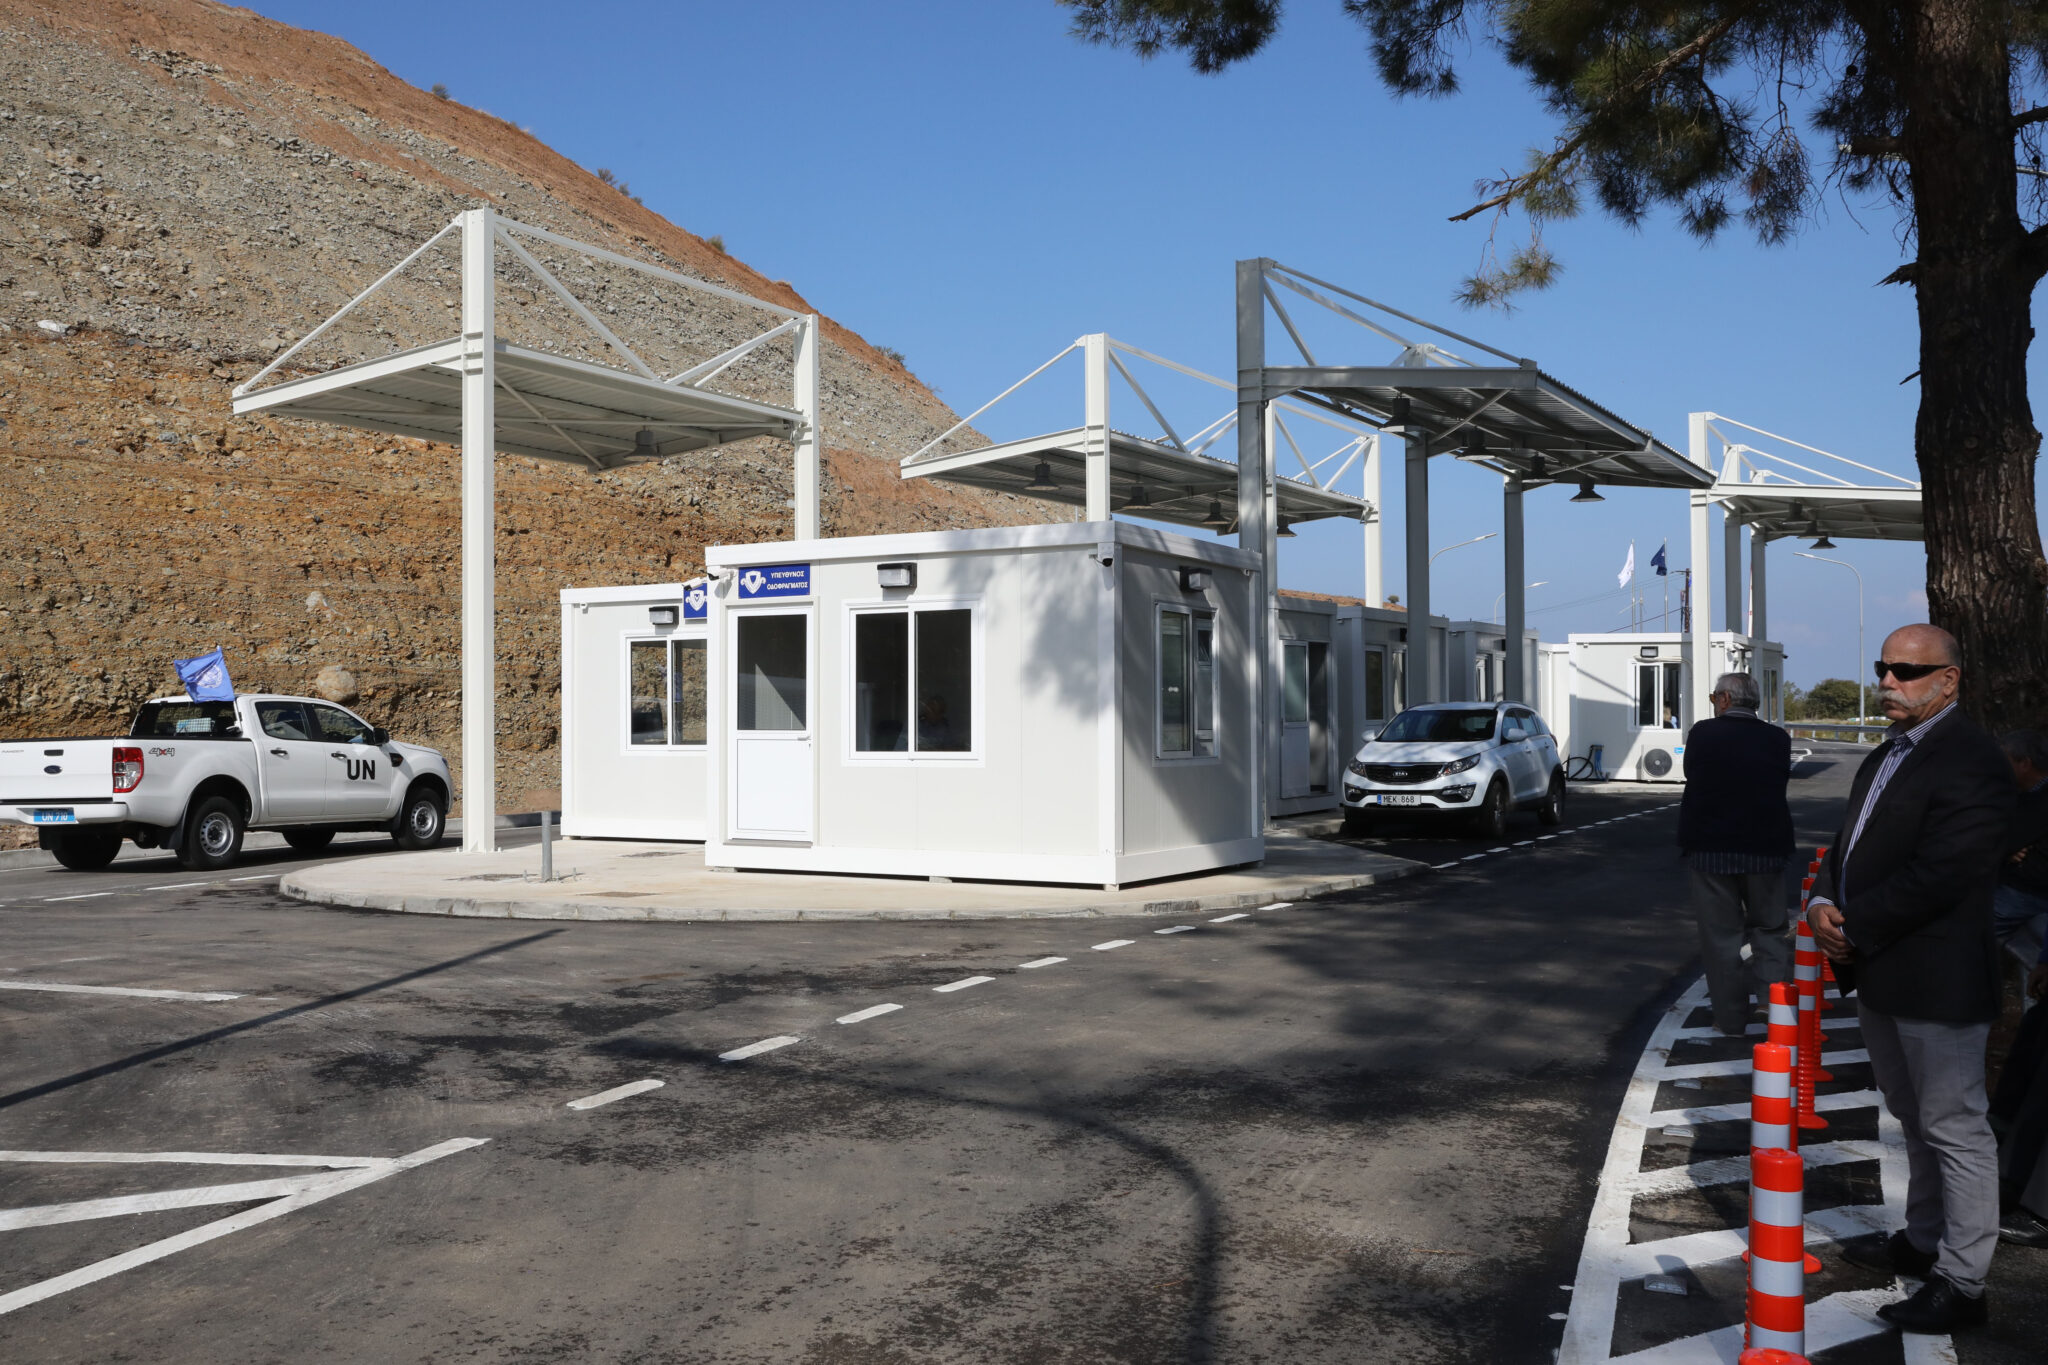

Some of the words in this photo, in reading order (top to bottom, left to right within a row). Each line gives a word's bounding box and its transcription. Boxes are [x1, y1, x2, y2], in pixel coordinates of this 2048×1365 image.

[770, 571, 805, 579] ΥΠΕΥΘΥΝΟΣ
[347, 759, 375, 780] UN
[1383, 795, 1397, 803] MEK
[1400, 795, 1415, 803] 868
